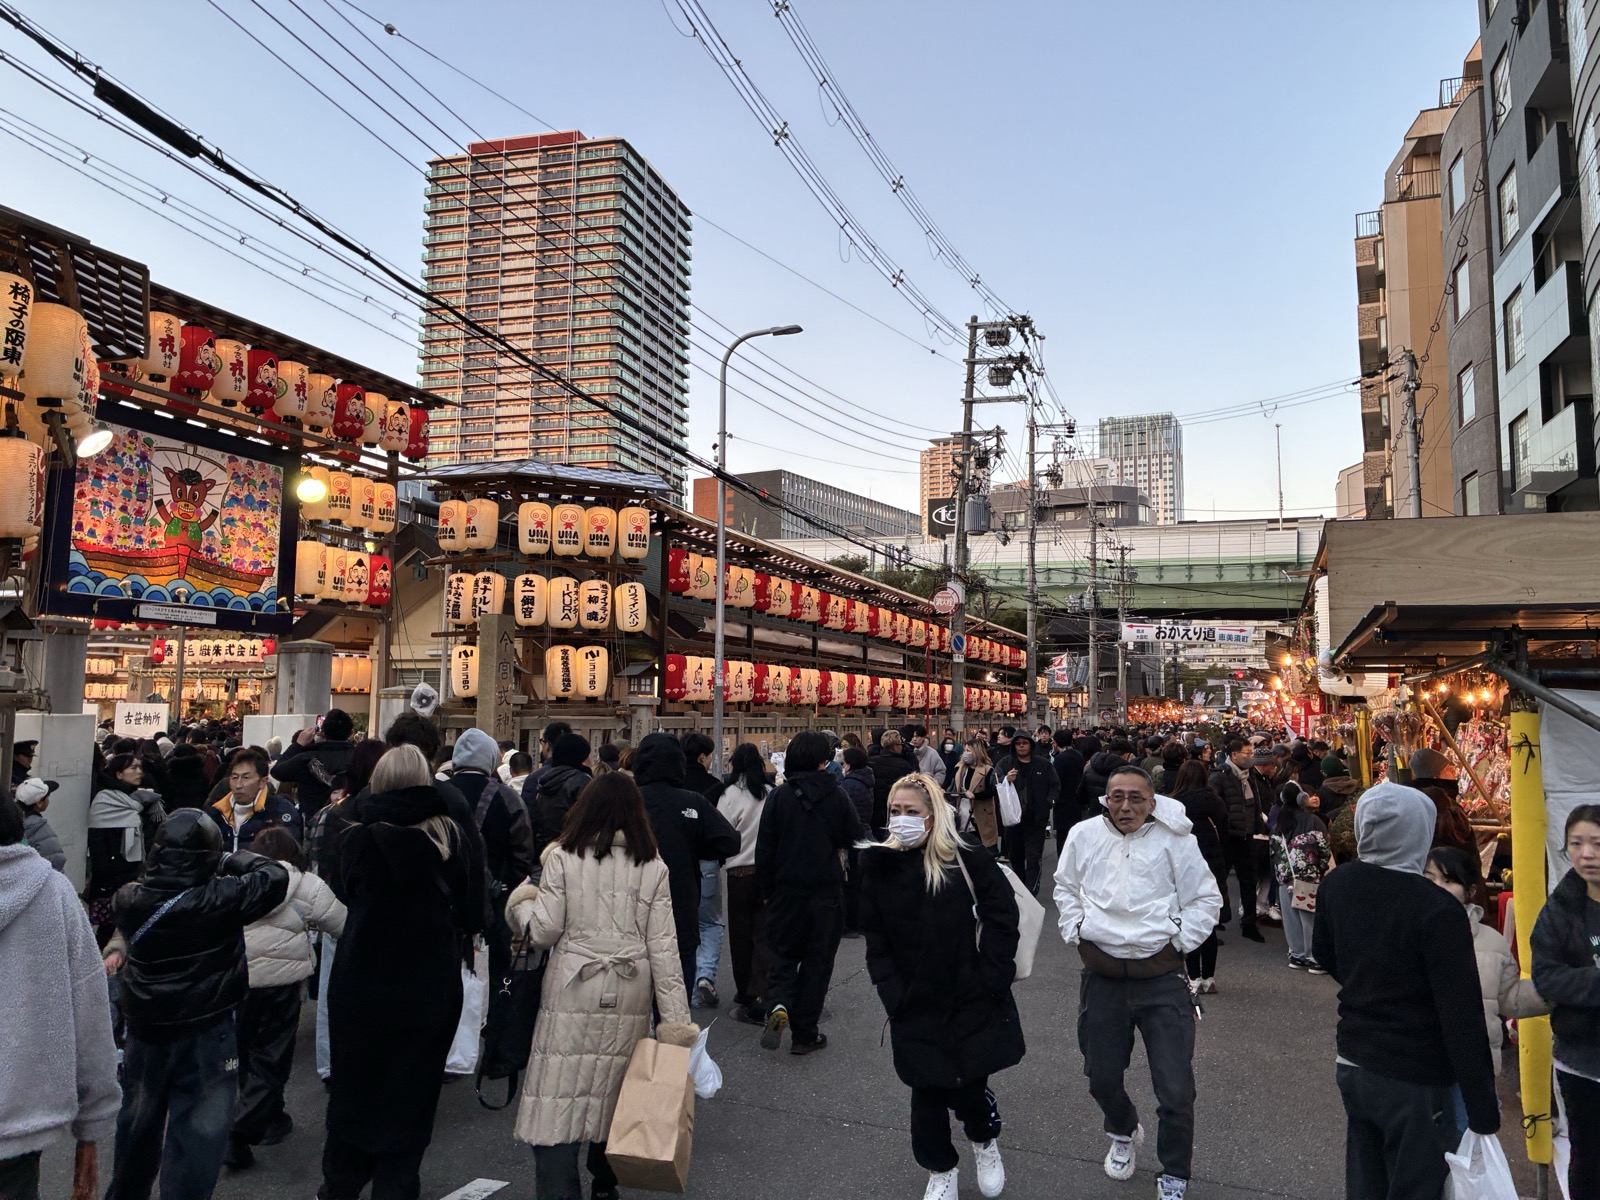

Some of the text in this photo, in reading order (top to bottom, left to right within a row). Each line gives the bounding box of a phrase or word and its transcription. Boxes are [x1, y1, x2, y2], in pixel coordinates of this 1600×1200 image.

[1, 281, 30, 366] 椅子の阪東
[159, 318, 177, 369] 今宮戎神社
[229, 344, 246, 392] 今宮戎神社
[528, 529, 548, 538] UHA
[558, 530, 579, 539] UHA
[589, 533, 609, 541] UHA
[628, 533, 647, 542] UHA
[521, 577, 535, 619] 丸一鋼管
[561, 583, 573, 621] IKURA
[1155, 626, 1216, 642] おかえり道
[1218, 633, 1249, 643] 恵美須町
[124, 711, 161, 726] 古笹納所
